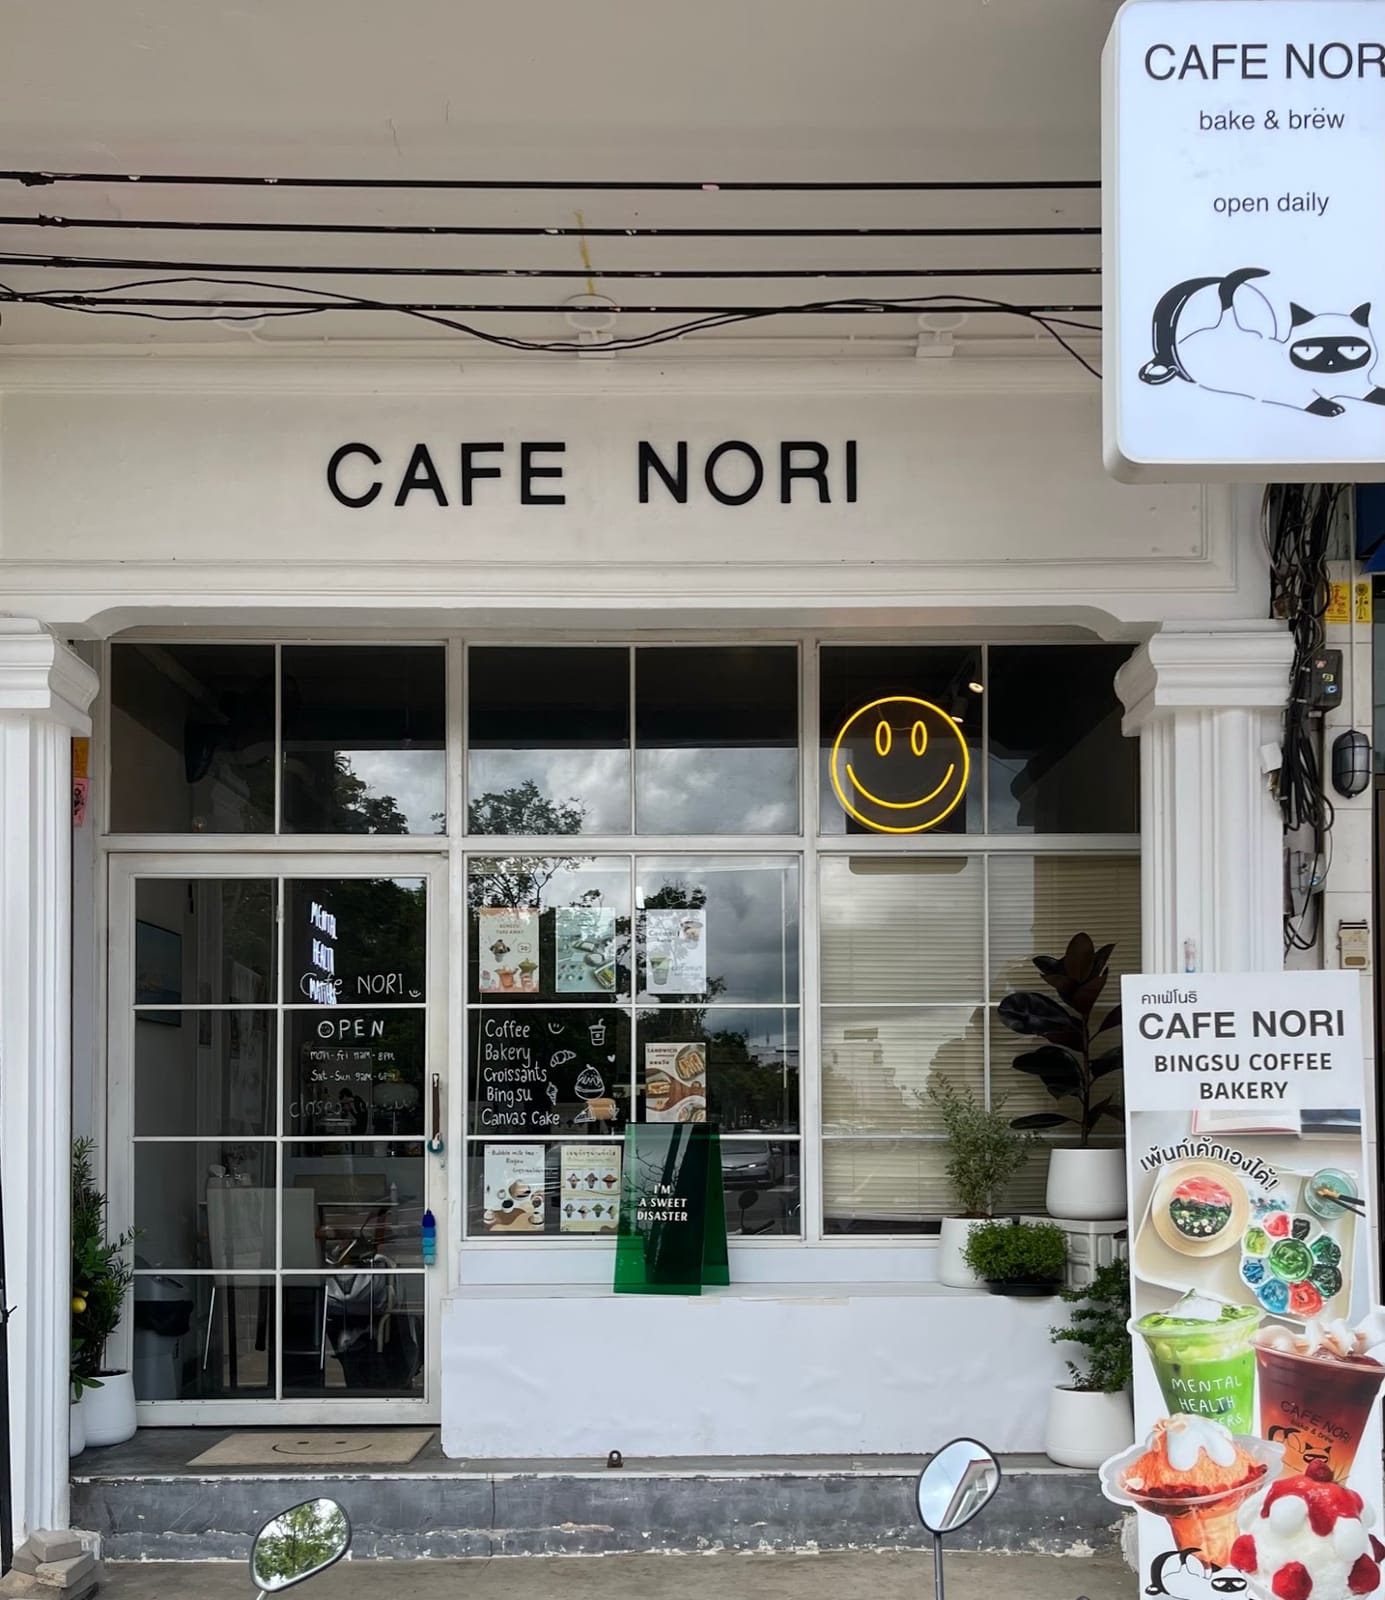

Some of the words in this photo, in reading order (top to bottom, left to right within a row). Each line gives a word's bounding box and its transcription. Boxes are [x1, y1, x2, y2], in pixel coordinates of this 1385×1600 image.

[1144, 43, 1268, 81] CAFE
[1200, 109, 1255, 130] bake
[1263, 109, 1280, 130] &
[1213, 195, 1269, 217] open
[1277, 192, 1330, 217] daily
[327, 441, 566, 508] CAFE
[638, 439, 858, 507] NORI
[357, 973, 403, 995] NORI
[1141, 988, 1198, 1005] คาเฟ่โนริ
[317, 1018, 385, 1041] OPEN
[485, 1018, 531, 1039] Coffee
[1139, 1010, 1236, 1040] CAFE
[1252, 1009, 1344, 1038] NORI
[485, 1043, 531, 1069] Bakery
[1154, 1053, 1240, 1073] BINGSU
[1249, 1052, 1333, 1071] COFFEE
[483, 1062, 547, 1083] Croissants
[487, 1086, 533, 1108] Bingsu
[1200, 1081, 1288, 1100] BAKERY
[481, 1107, 526, 1126] Canvas
[653, 1182, 671, 1195] I'M
[639, 1198, 648, 1209] A
[650, 1197, 688, 1209] SWEET
[637, 1210, 688, 1222] DISASTER
[1171, 1376, 1242, 1393] MENTAL
[1179, 1395, 1236, 1413] HEALTH
[1281, 1400, 1322, 1427] CAFE
